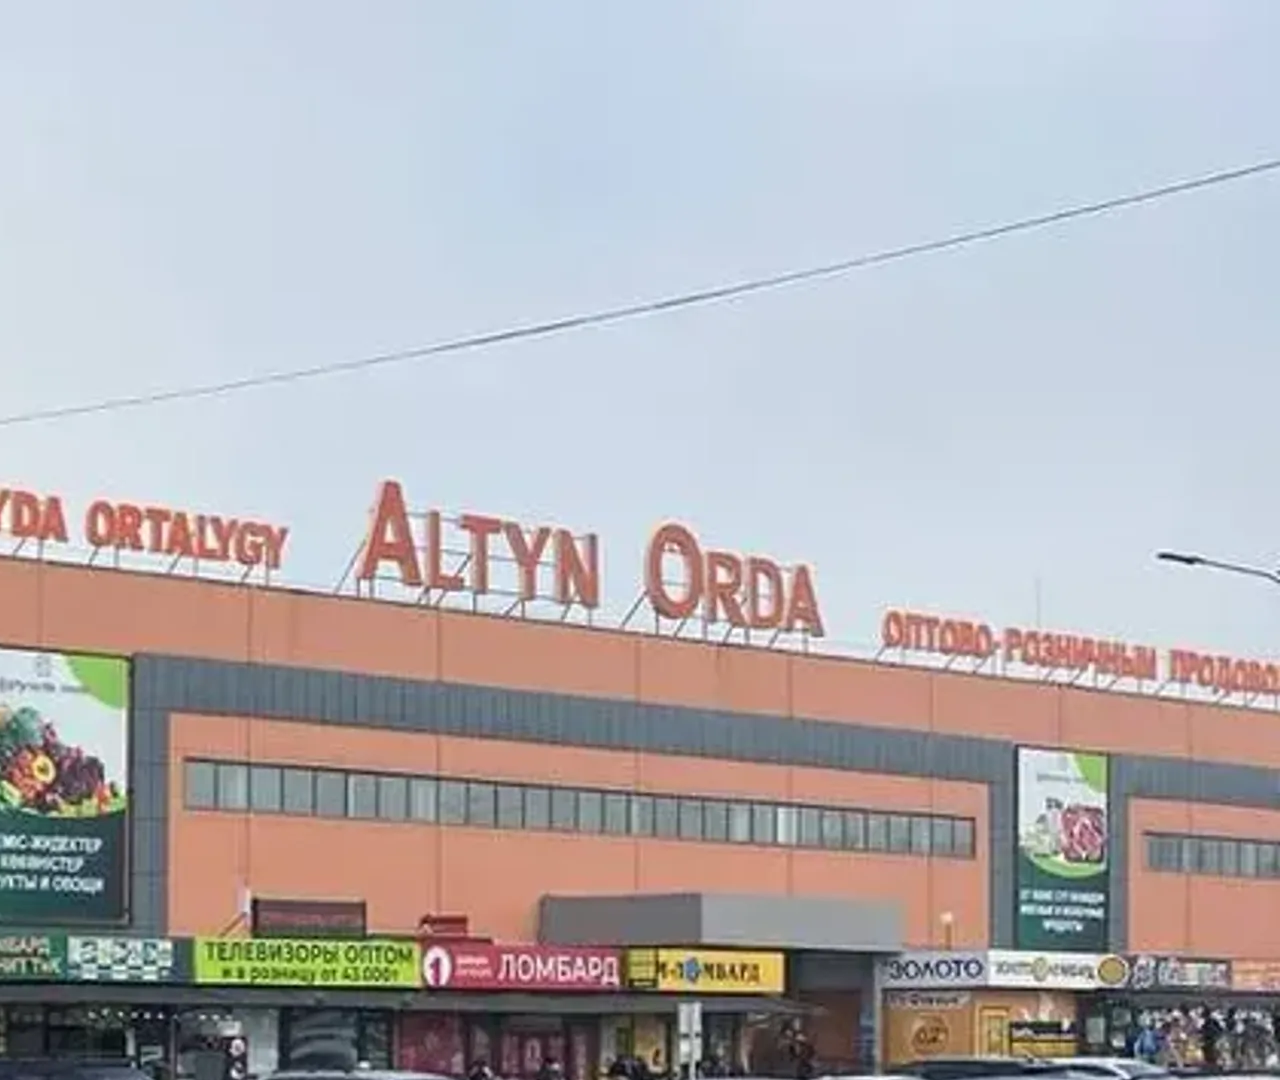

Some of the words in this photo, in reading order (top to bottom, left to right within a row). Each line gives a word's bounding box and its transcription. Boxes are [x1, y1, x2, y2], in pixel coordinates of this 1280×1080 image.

[85, 500, 288, 568] ORTALYGY
[356, 480, 600, 609] ALTYN
[646, 523, 825, 637] ORDA
[52, 876, 104, 896] ОВОЩИ
[204, 942, 339, 964] ТЕЛЕВИЗОРЫ
[344, 944, 413, 965] ОПТОМ
[250, 967, 315, 984] розницу
[320, 969, 337, 982] от
[497, 954, 620, 986] ЛОМБАРД
[889, 959, 983, 980] ЗОЛОТО
